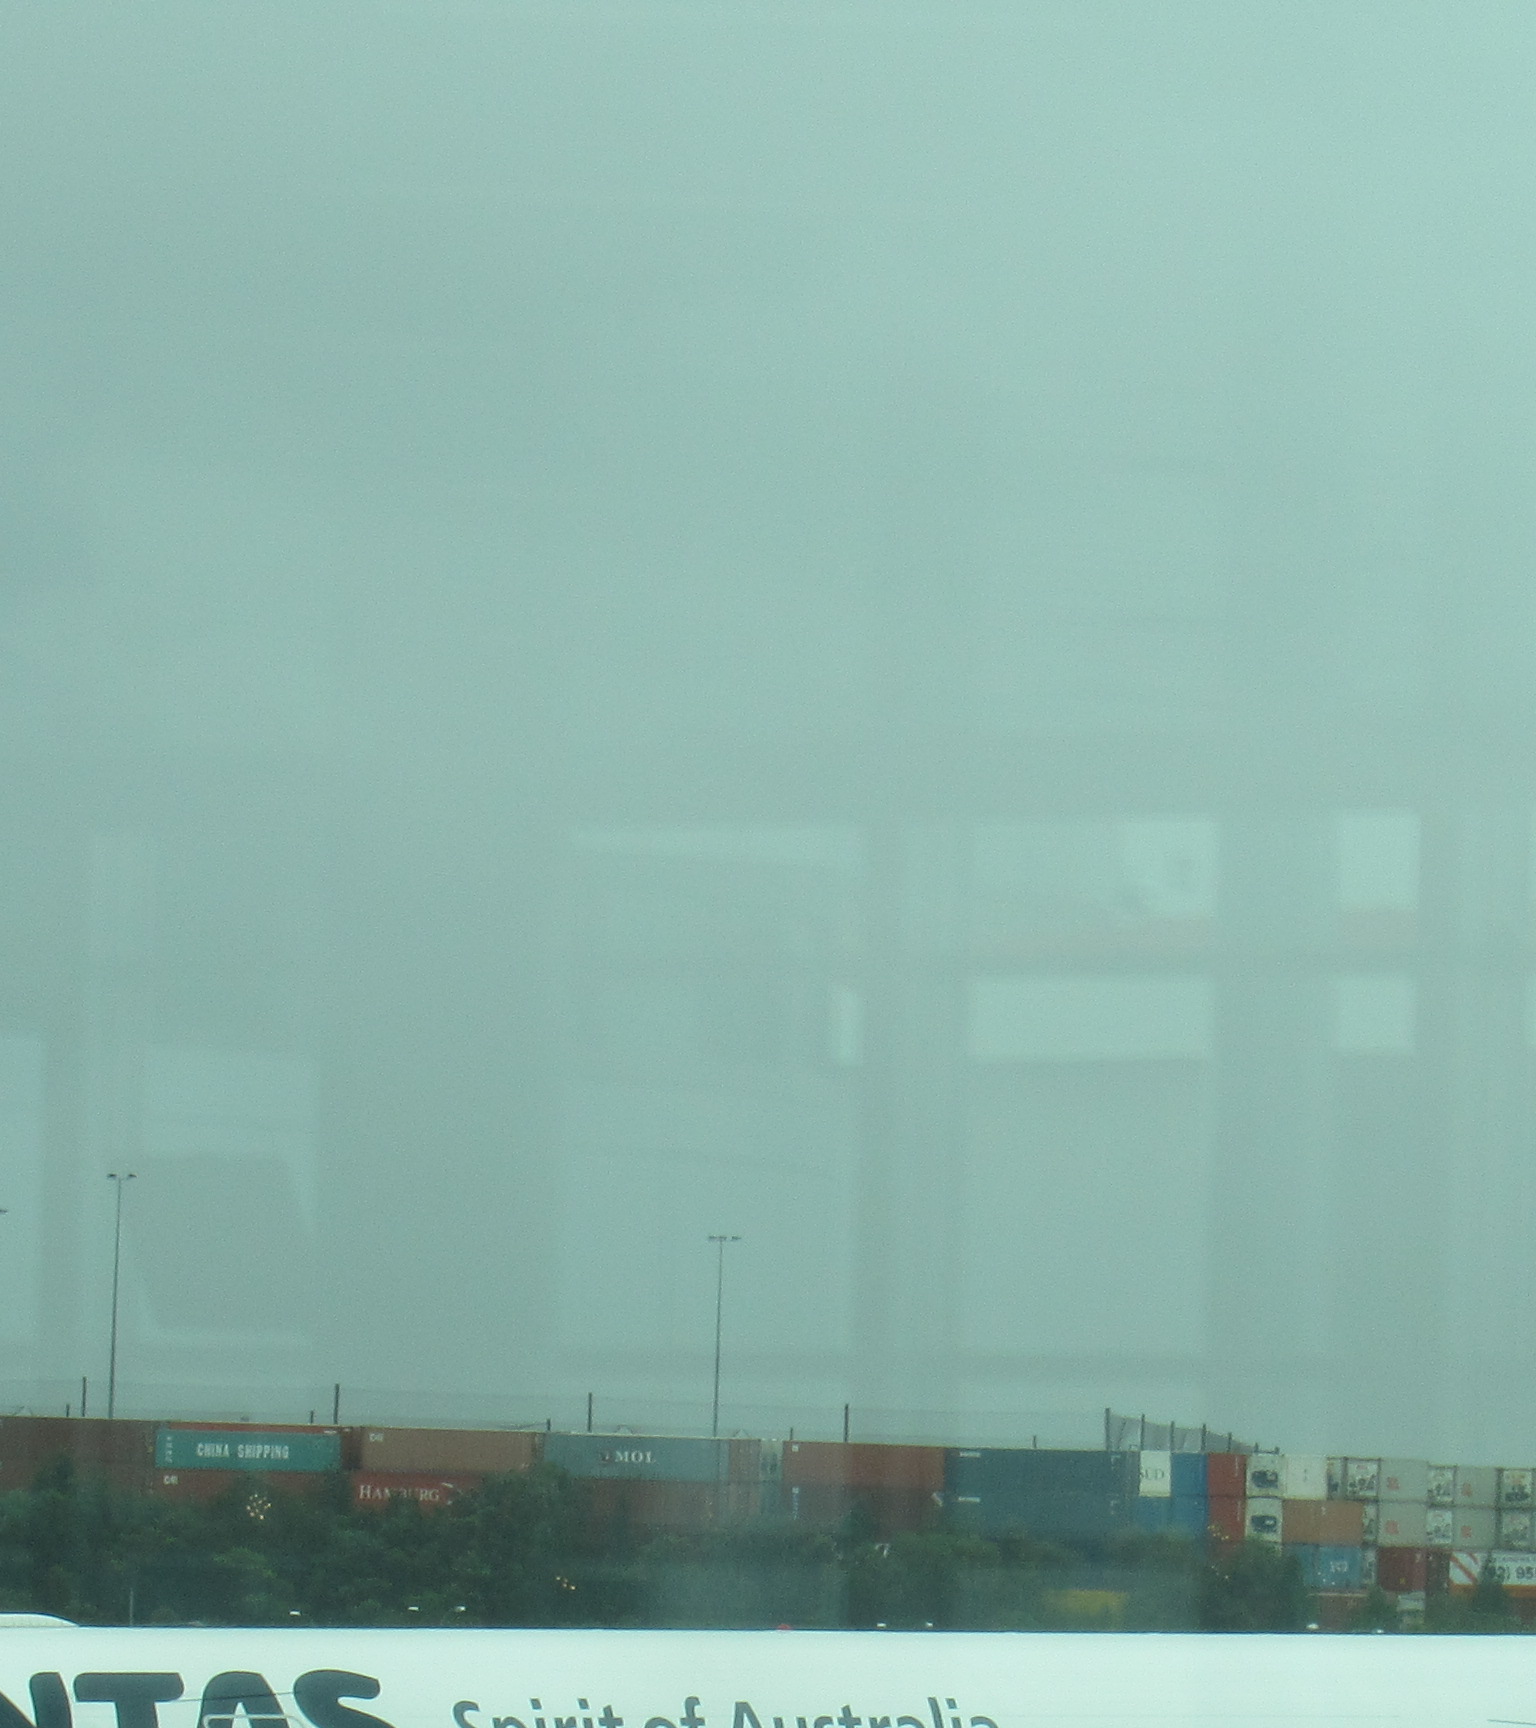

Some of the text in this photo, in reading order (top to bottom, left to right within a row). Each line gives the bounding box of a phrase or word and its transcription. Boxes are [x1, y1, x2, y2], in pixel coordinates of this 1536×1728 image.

[196, 1443, 290, 1460] CHINA SHIPPING
[615, 1450, 657, 1464] MOL
